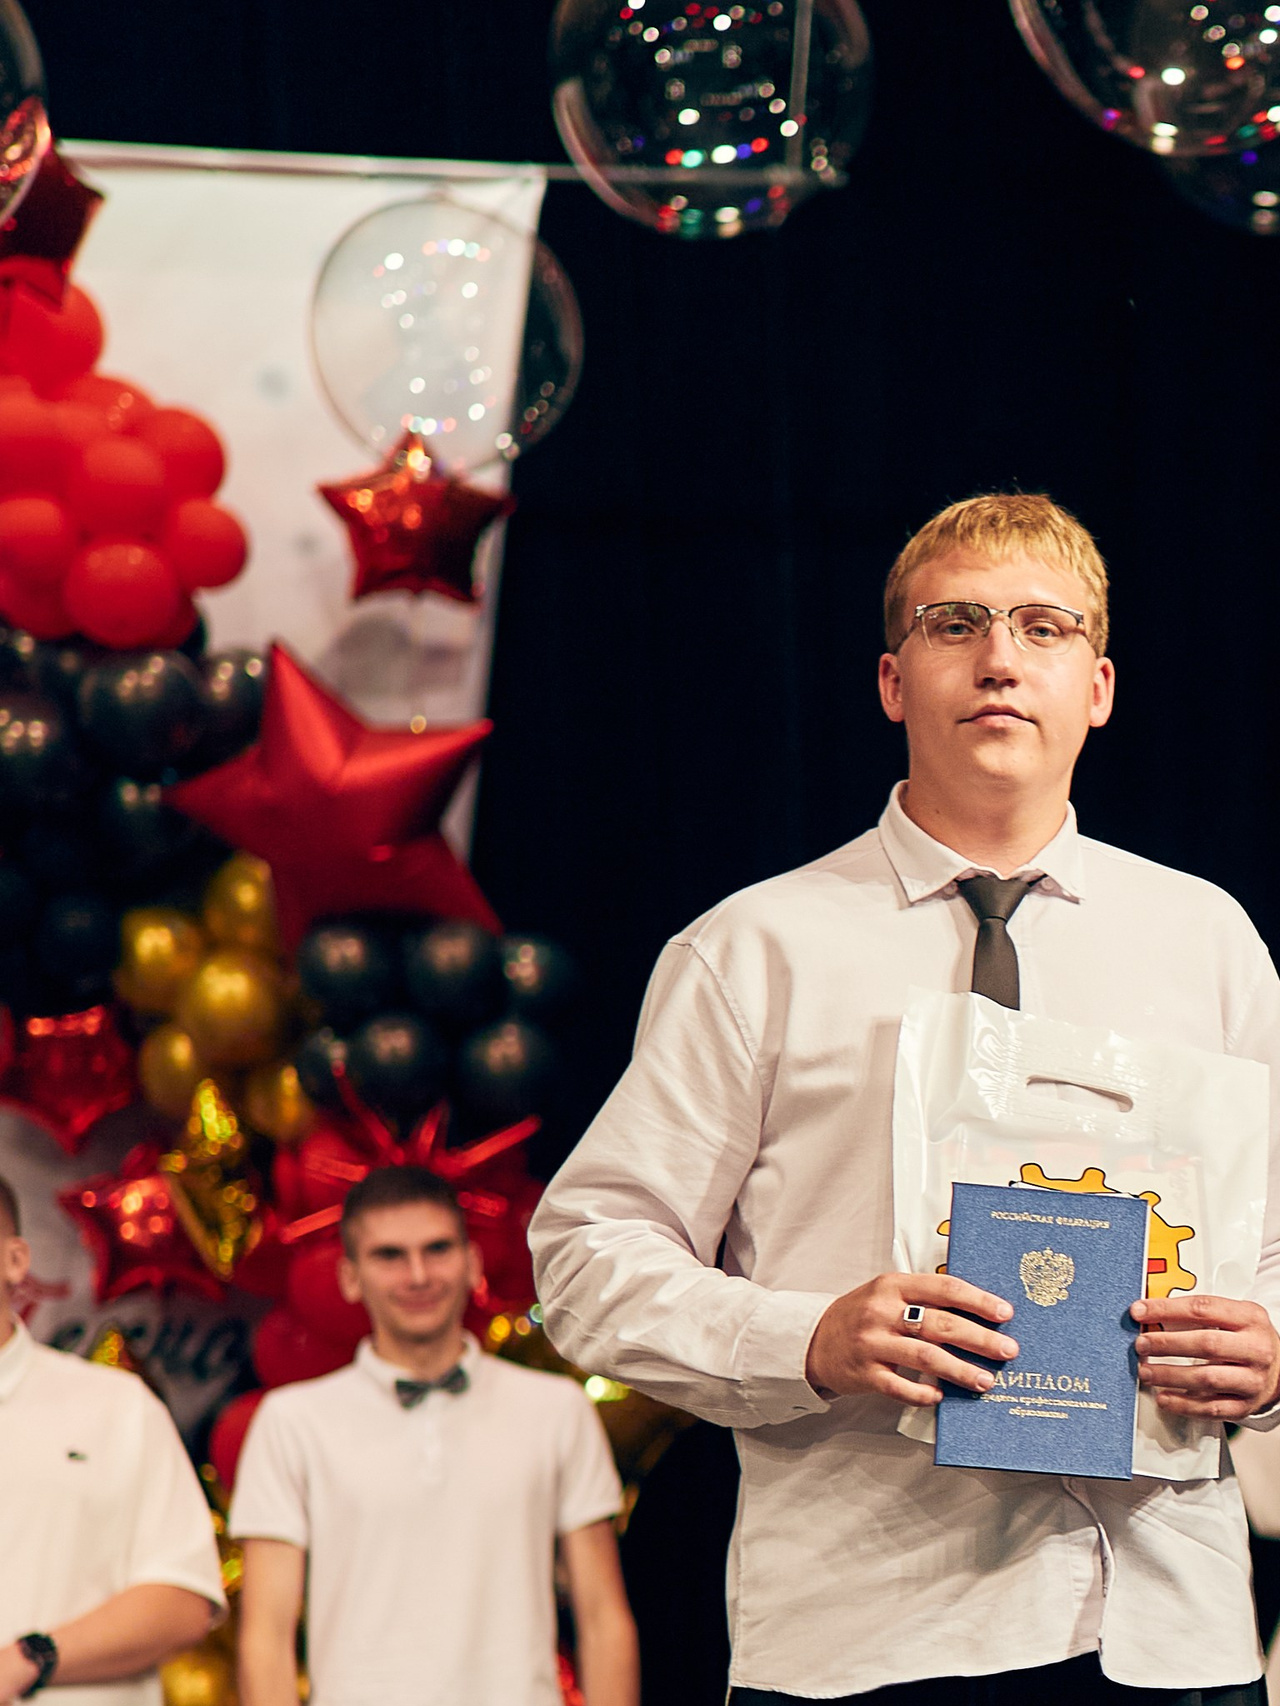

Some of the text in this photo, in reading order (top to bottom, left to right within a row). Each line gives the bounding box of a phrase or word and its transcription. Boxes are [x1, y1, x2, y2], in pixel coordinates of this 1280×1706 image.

[991, 1211, 1110, 1229] РОССИЙСКАЯ ФЕДЕРАЦИЯ
[994, 1370, 1090, 1393] ДИПЛОМ
